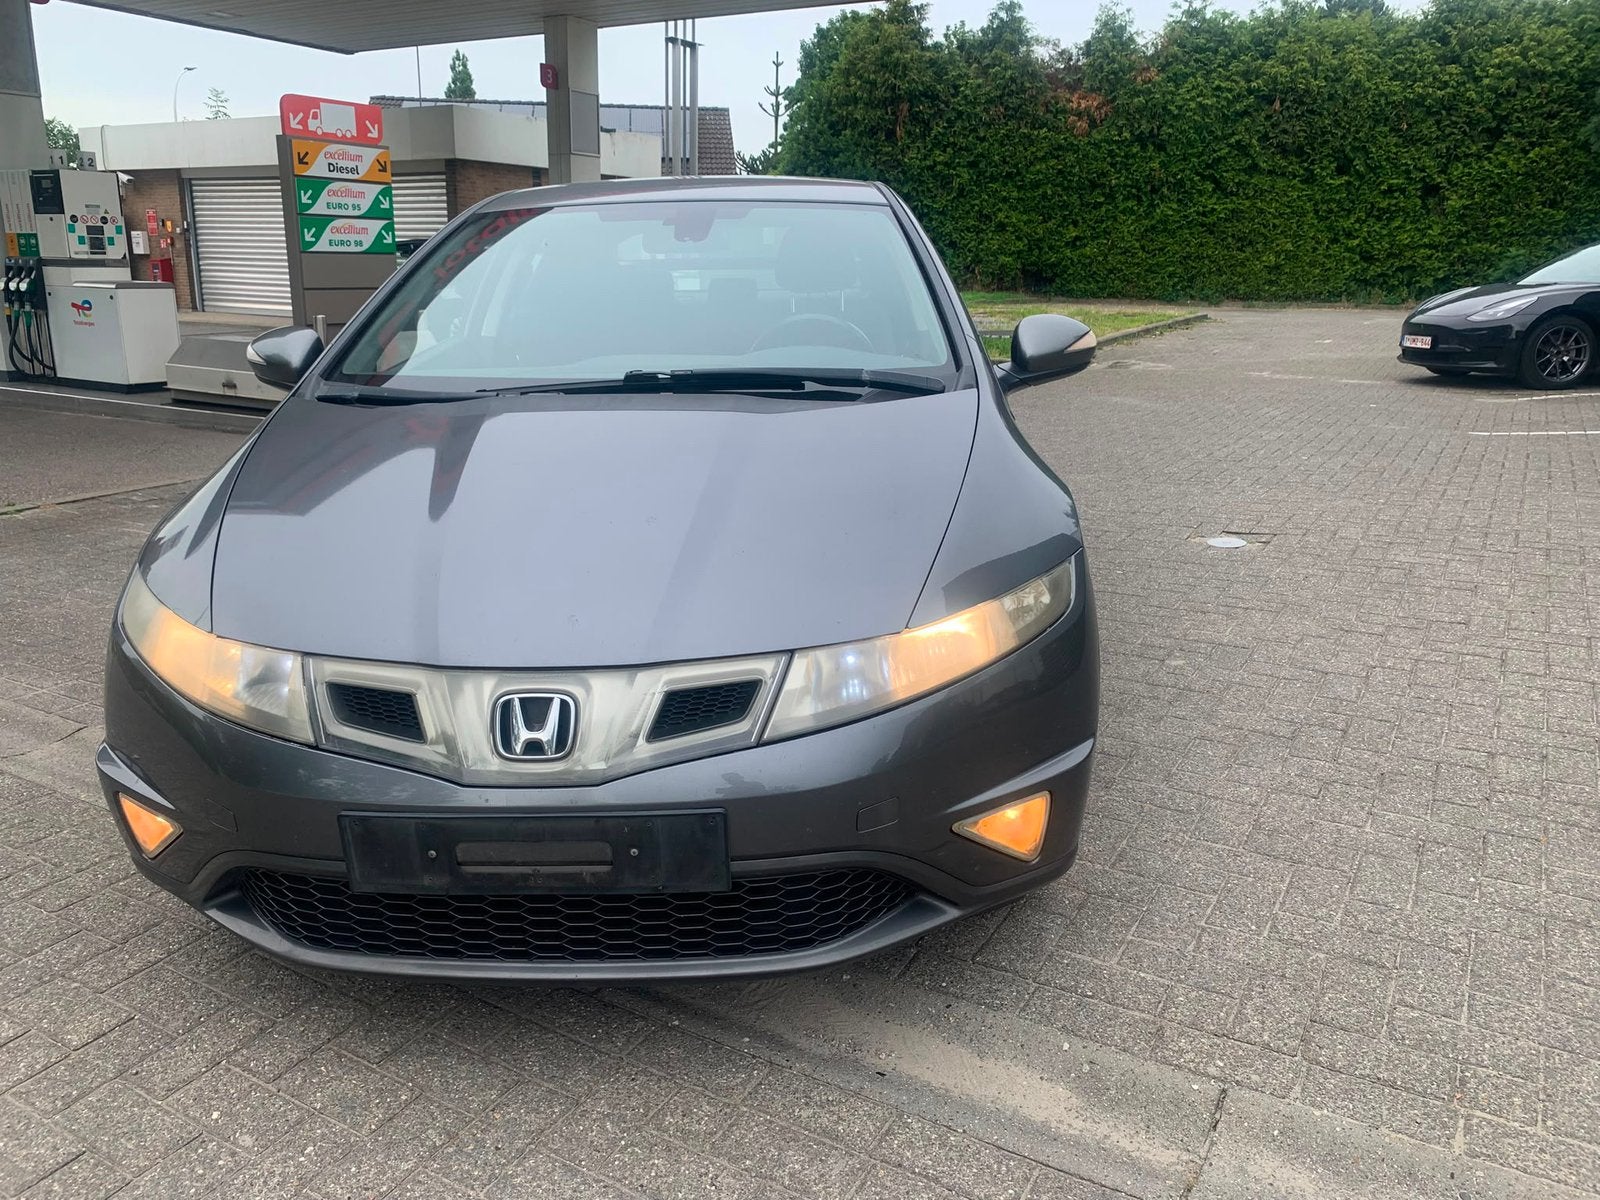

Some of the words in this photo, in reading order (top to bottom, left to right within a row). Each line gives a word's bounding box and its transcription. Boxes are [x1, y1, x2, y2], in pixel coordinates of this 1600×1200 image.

[545, 68, 553, 84] 3
[87, 157, 95, 167] 2
[324, 149, 363, 163] excellium
[328, 162, 360, 176] Diesel
[327, 187, 366, 200] excellium
[326, 202, 350, 211] EURO
[351, 203, 362, 212] 95
[330, 224, 369, 236] excellium
[328, 239, 351, 247] EURO
[353, 239, 363, 248] 98
